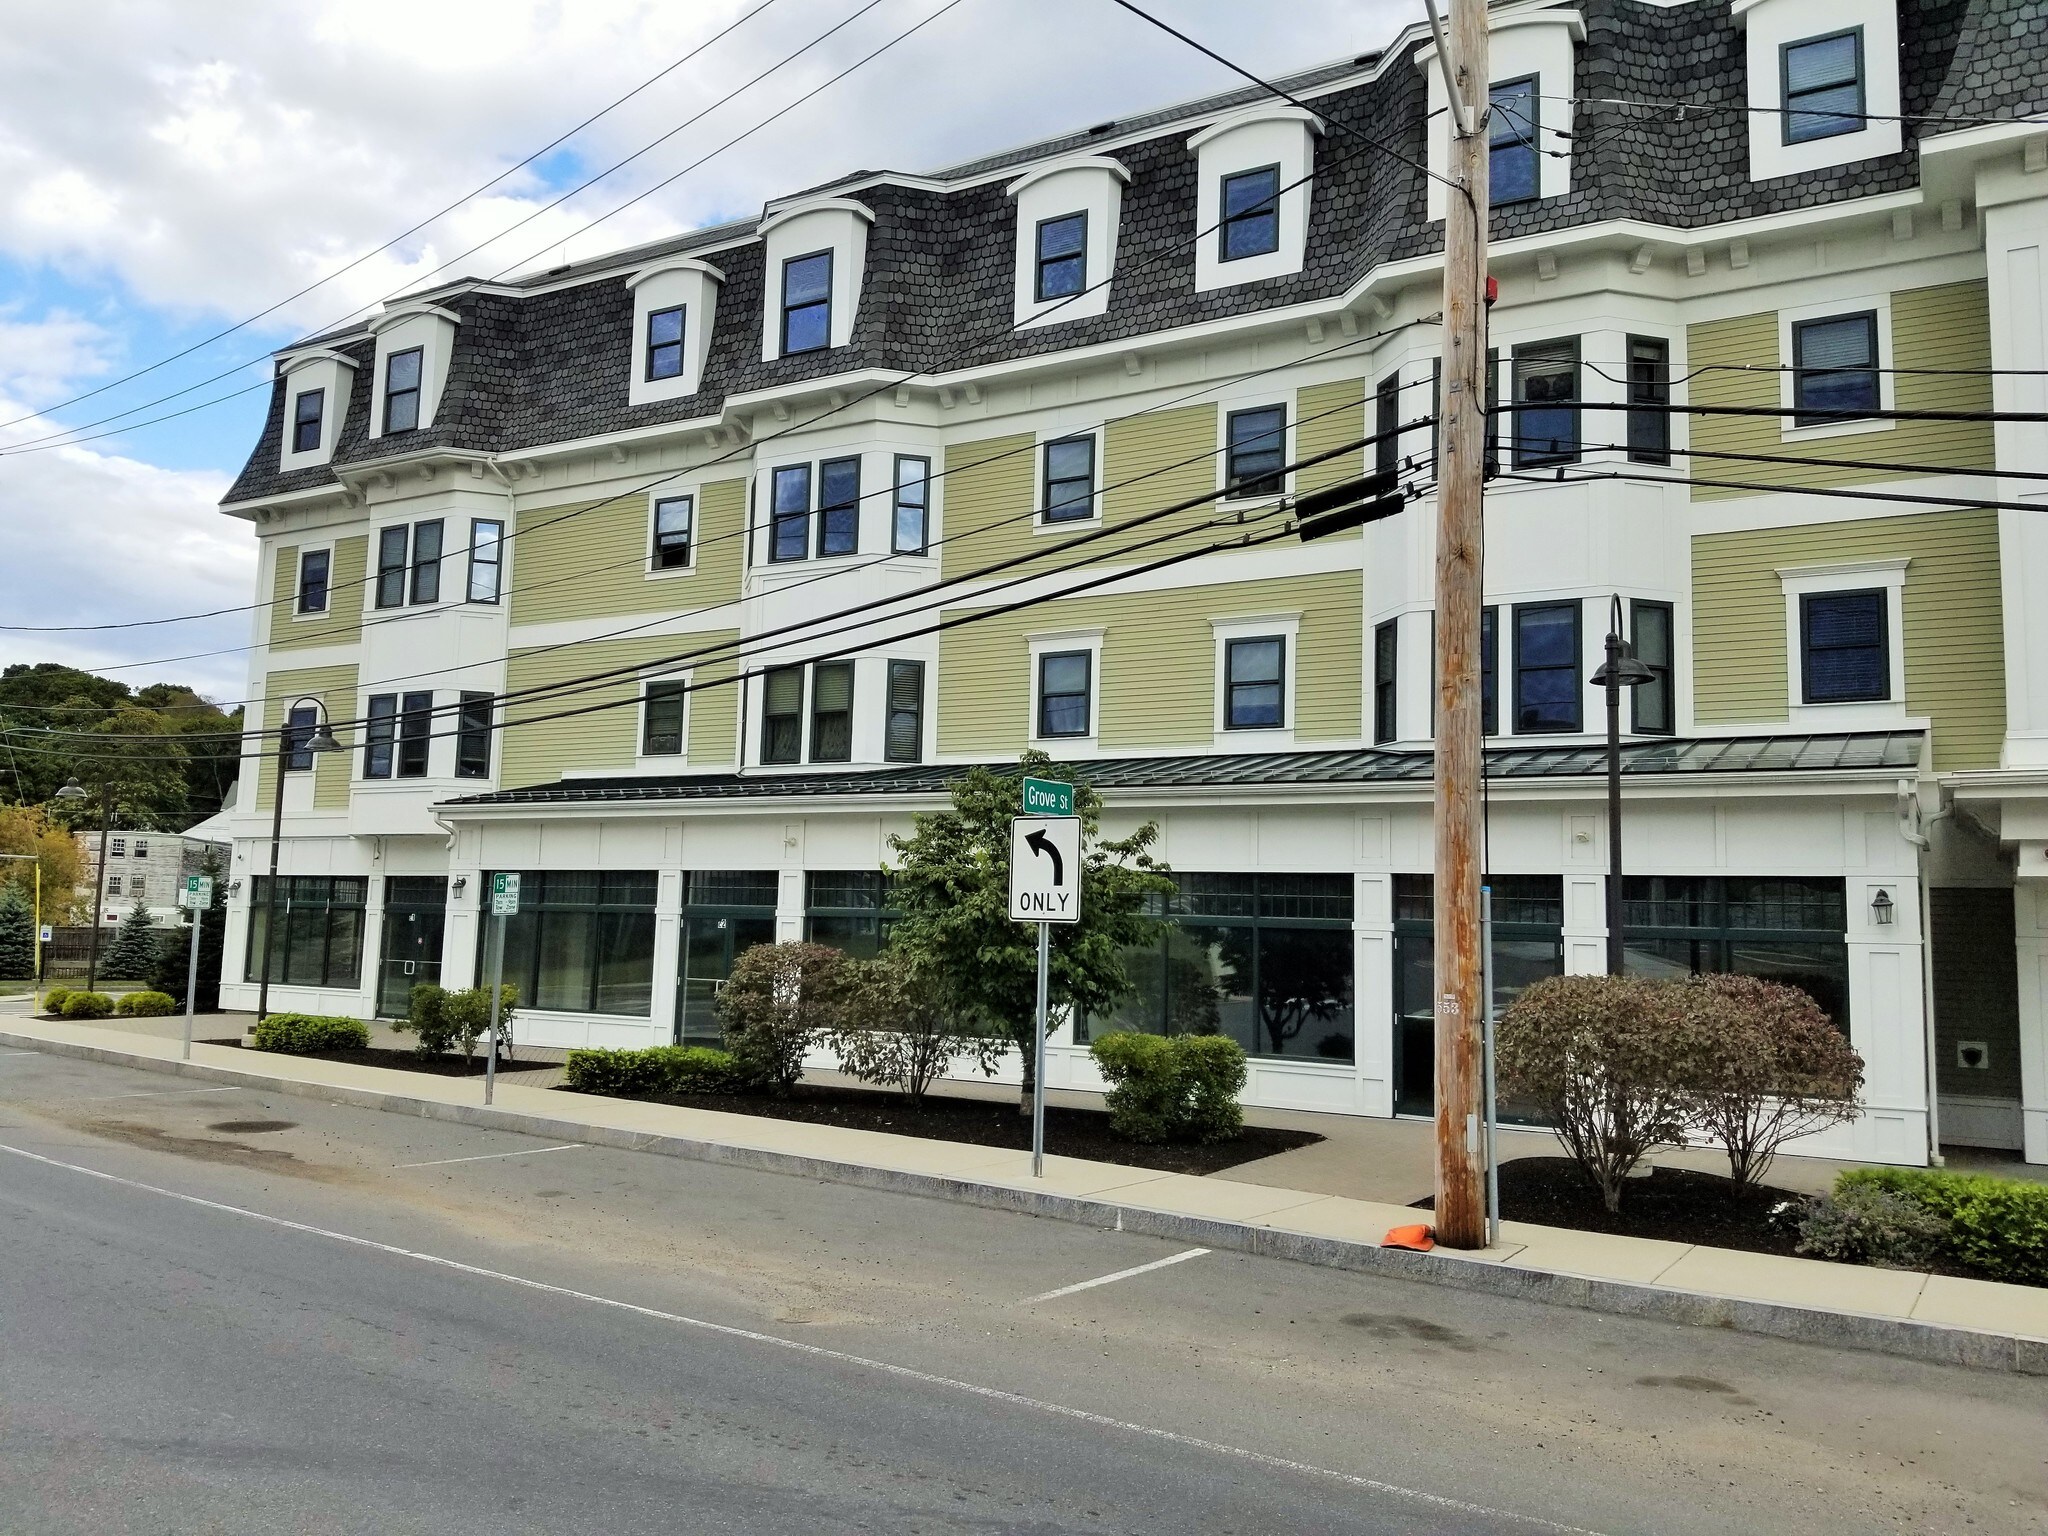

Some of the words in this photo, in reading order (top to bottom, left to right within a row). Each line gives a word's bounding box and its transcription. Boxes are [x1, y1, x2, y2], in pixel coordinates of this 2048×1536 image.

[1028, 786, 1056, 808] Grove
[1059, 794, 1068, 810] St
[189, 880, 198, 889] 15
[199, 881, 210, 889] MIN
[496, 878, 505, 890] 15
[506, 879, 518, 889] MIN
[1020, 892, 1069, 911] ONLY
